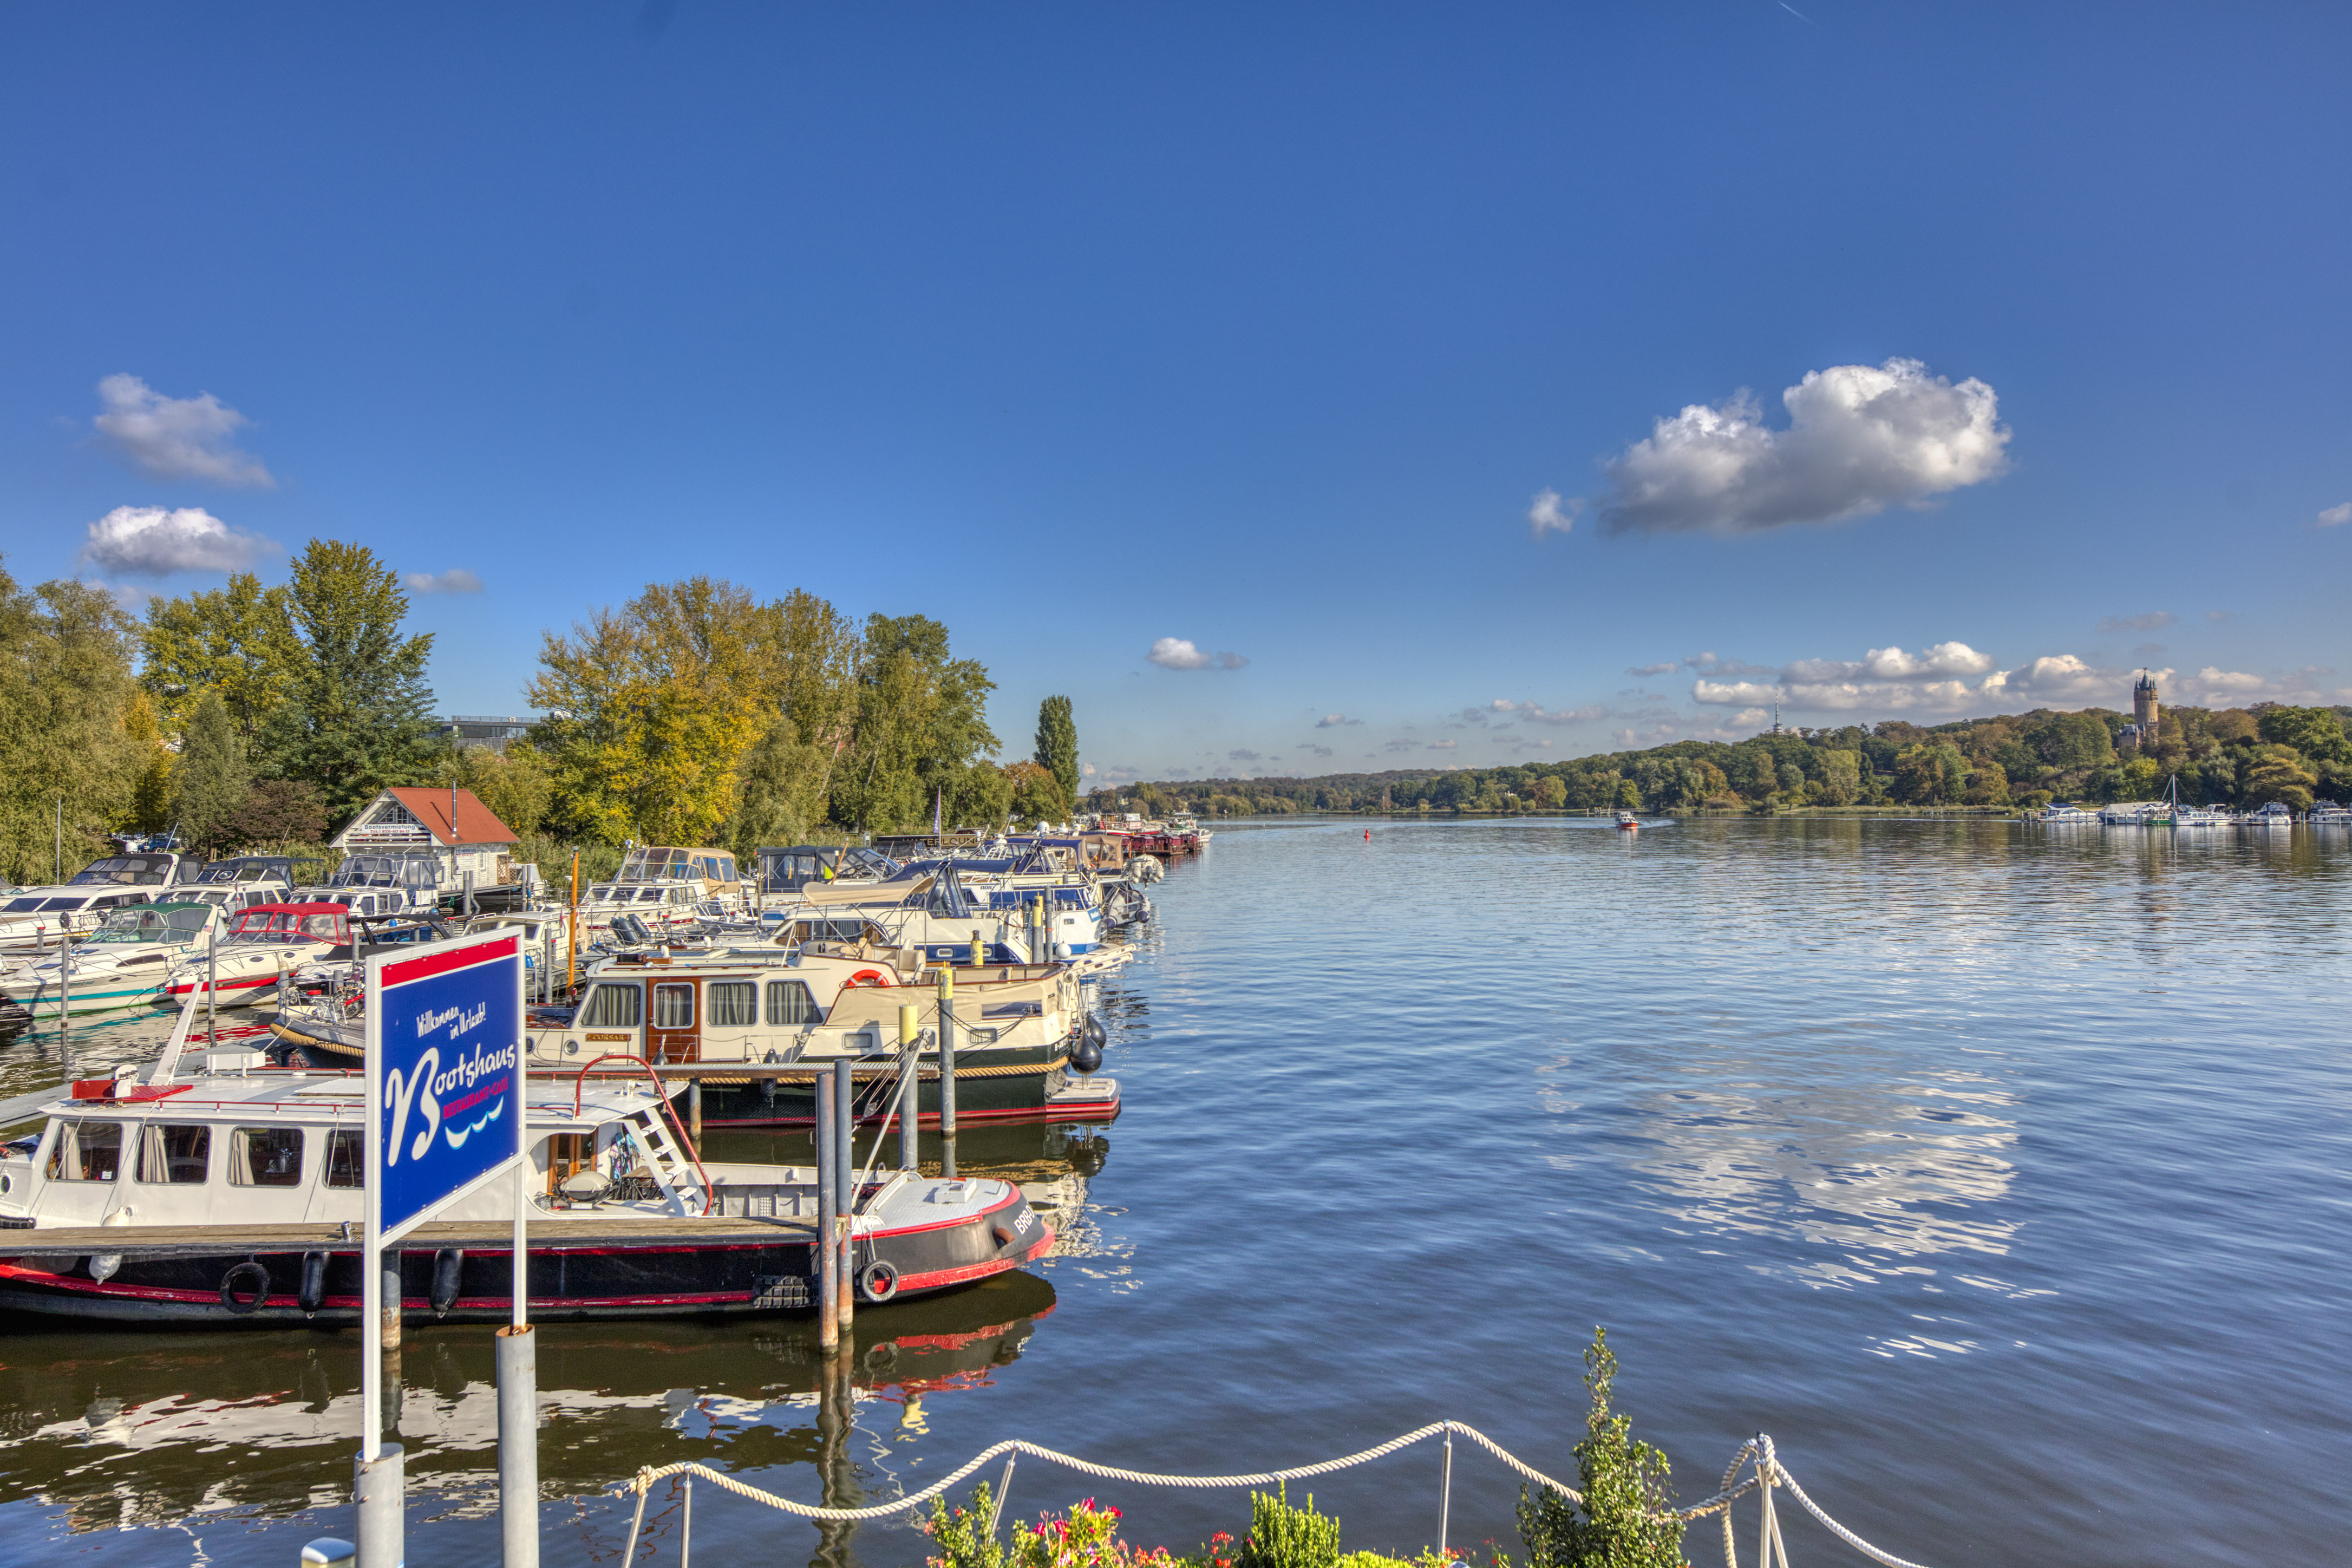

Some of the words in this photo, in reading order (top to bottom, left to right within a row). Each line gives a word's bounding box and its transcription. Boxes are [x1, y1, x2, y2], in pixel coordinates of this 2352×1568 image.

[416, 1007, 459, 1037] Willkommen
[450, 1024, 459, 1040] im
[459, 1002, 486, 1034] Urlaub!
[385, 1043, 515, 1167] Bootshaus
